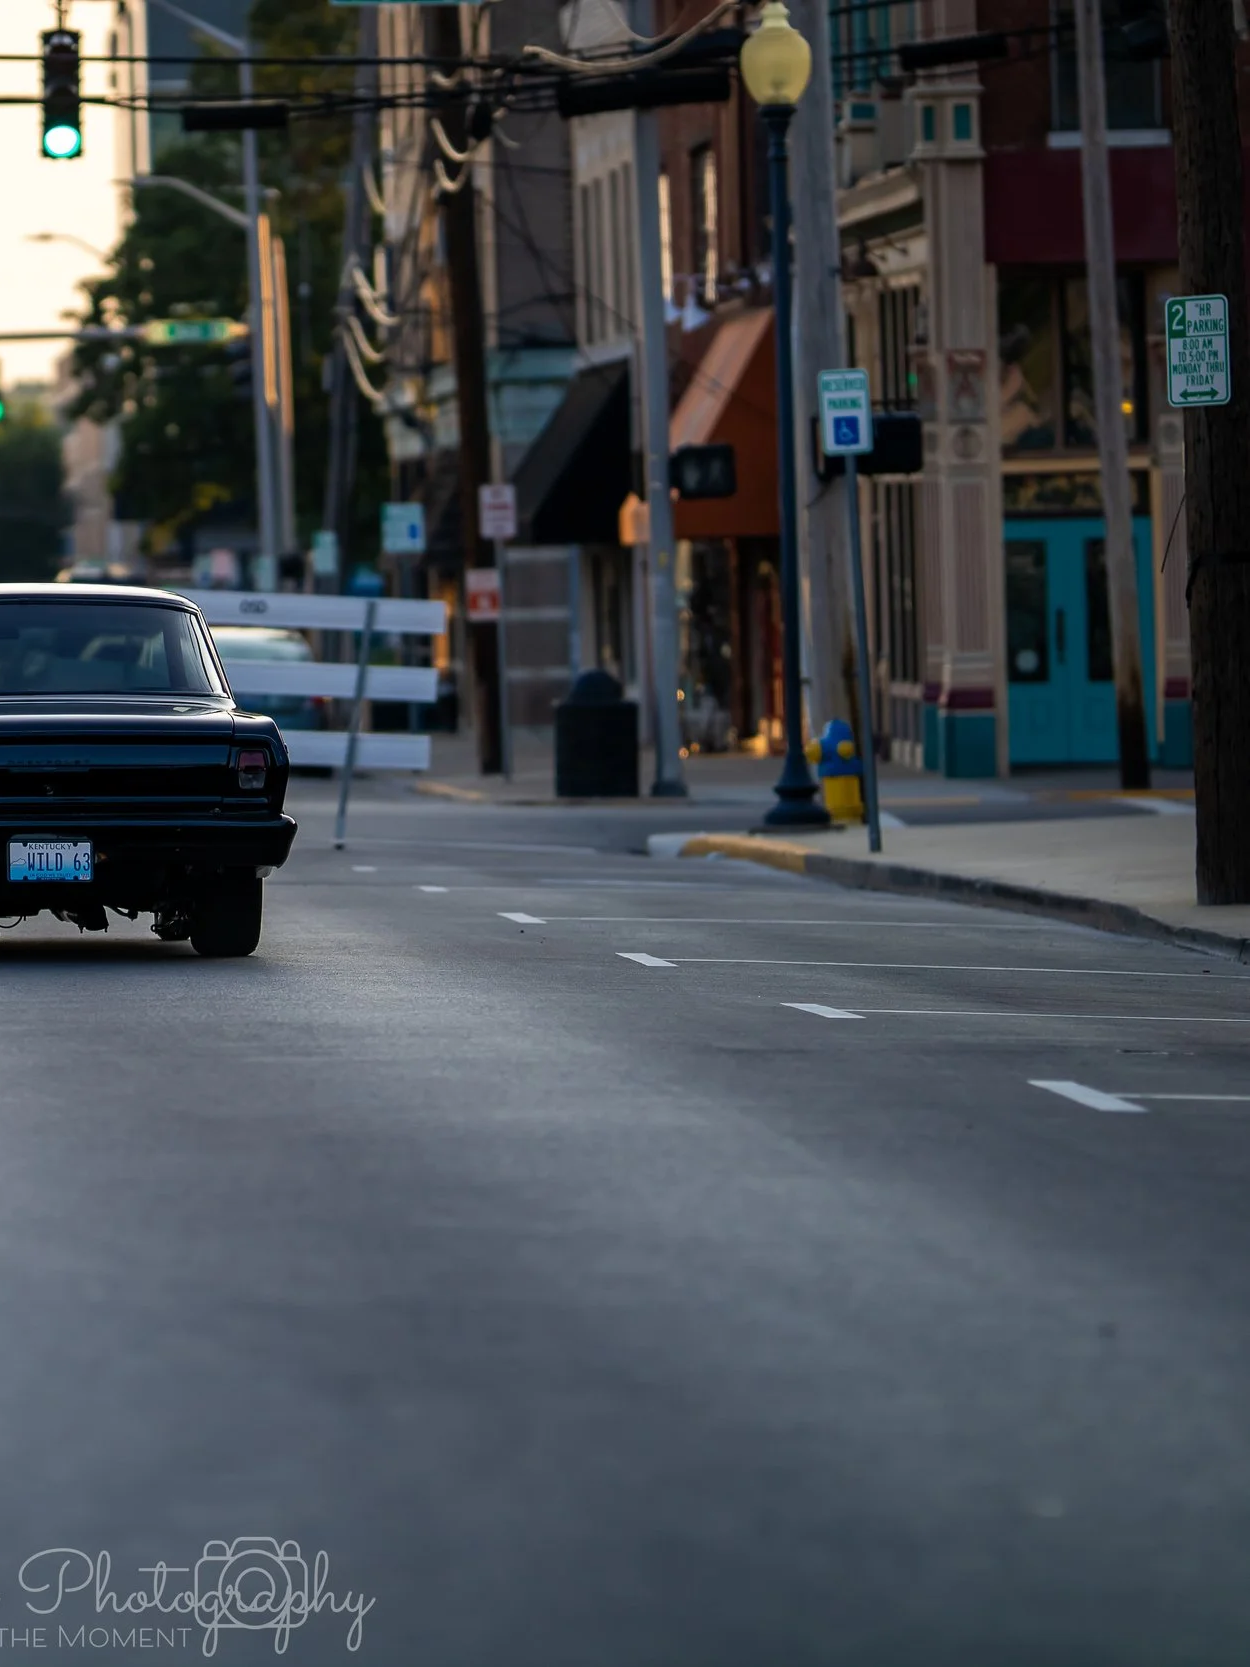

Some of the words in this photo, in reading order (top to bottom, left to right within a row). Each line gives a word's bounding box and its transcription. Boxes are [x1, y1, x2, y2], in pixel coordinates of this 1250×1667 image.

[1171, 304, 1184, 331] 2
[1199, 303, 1212, 316] HR
[1187, 319, 1224, 333] PARKING
[1182, 339, 1200, 350] 8:00
[1202, 338, 1213, 349] AM
[1178, 352, 1187, 362] TO
[1189, 351, 1206, 362] 5:00
[1208, 350, 1219, 361] PM
[1172, 363, 1201, 375] MONDAY
[1206, 361, 1225, 373] THRU
[1186, 374, 1215, 386] FRIDAY
[27, 852, 63, 871] WILD
[73, 852, 90, 871] 63
